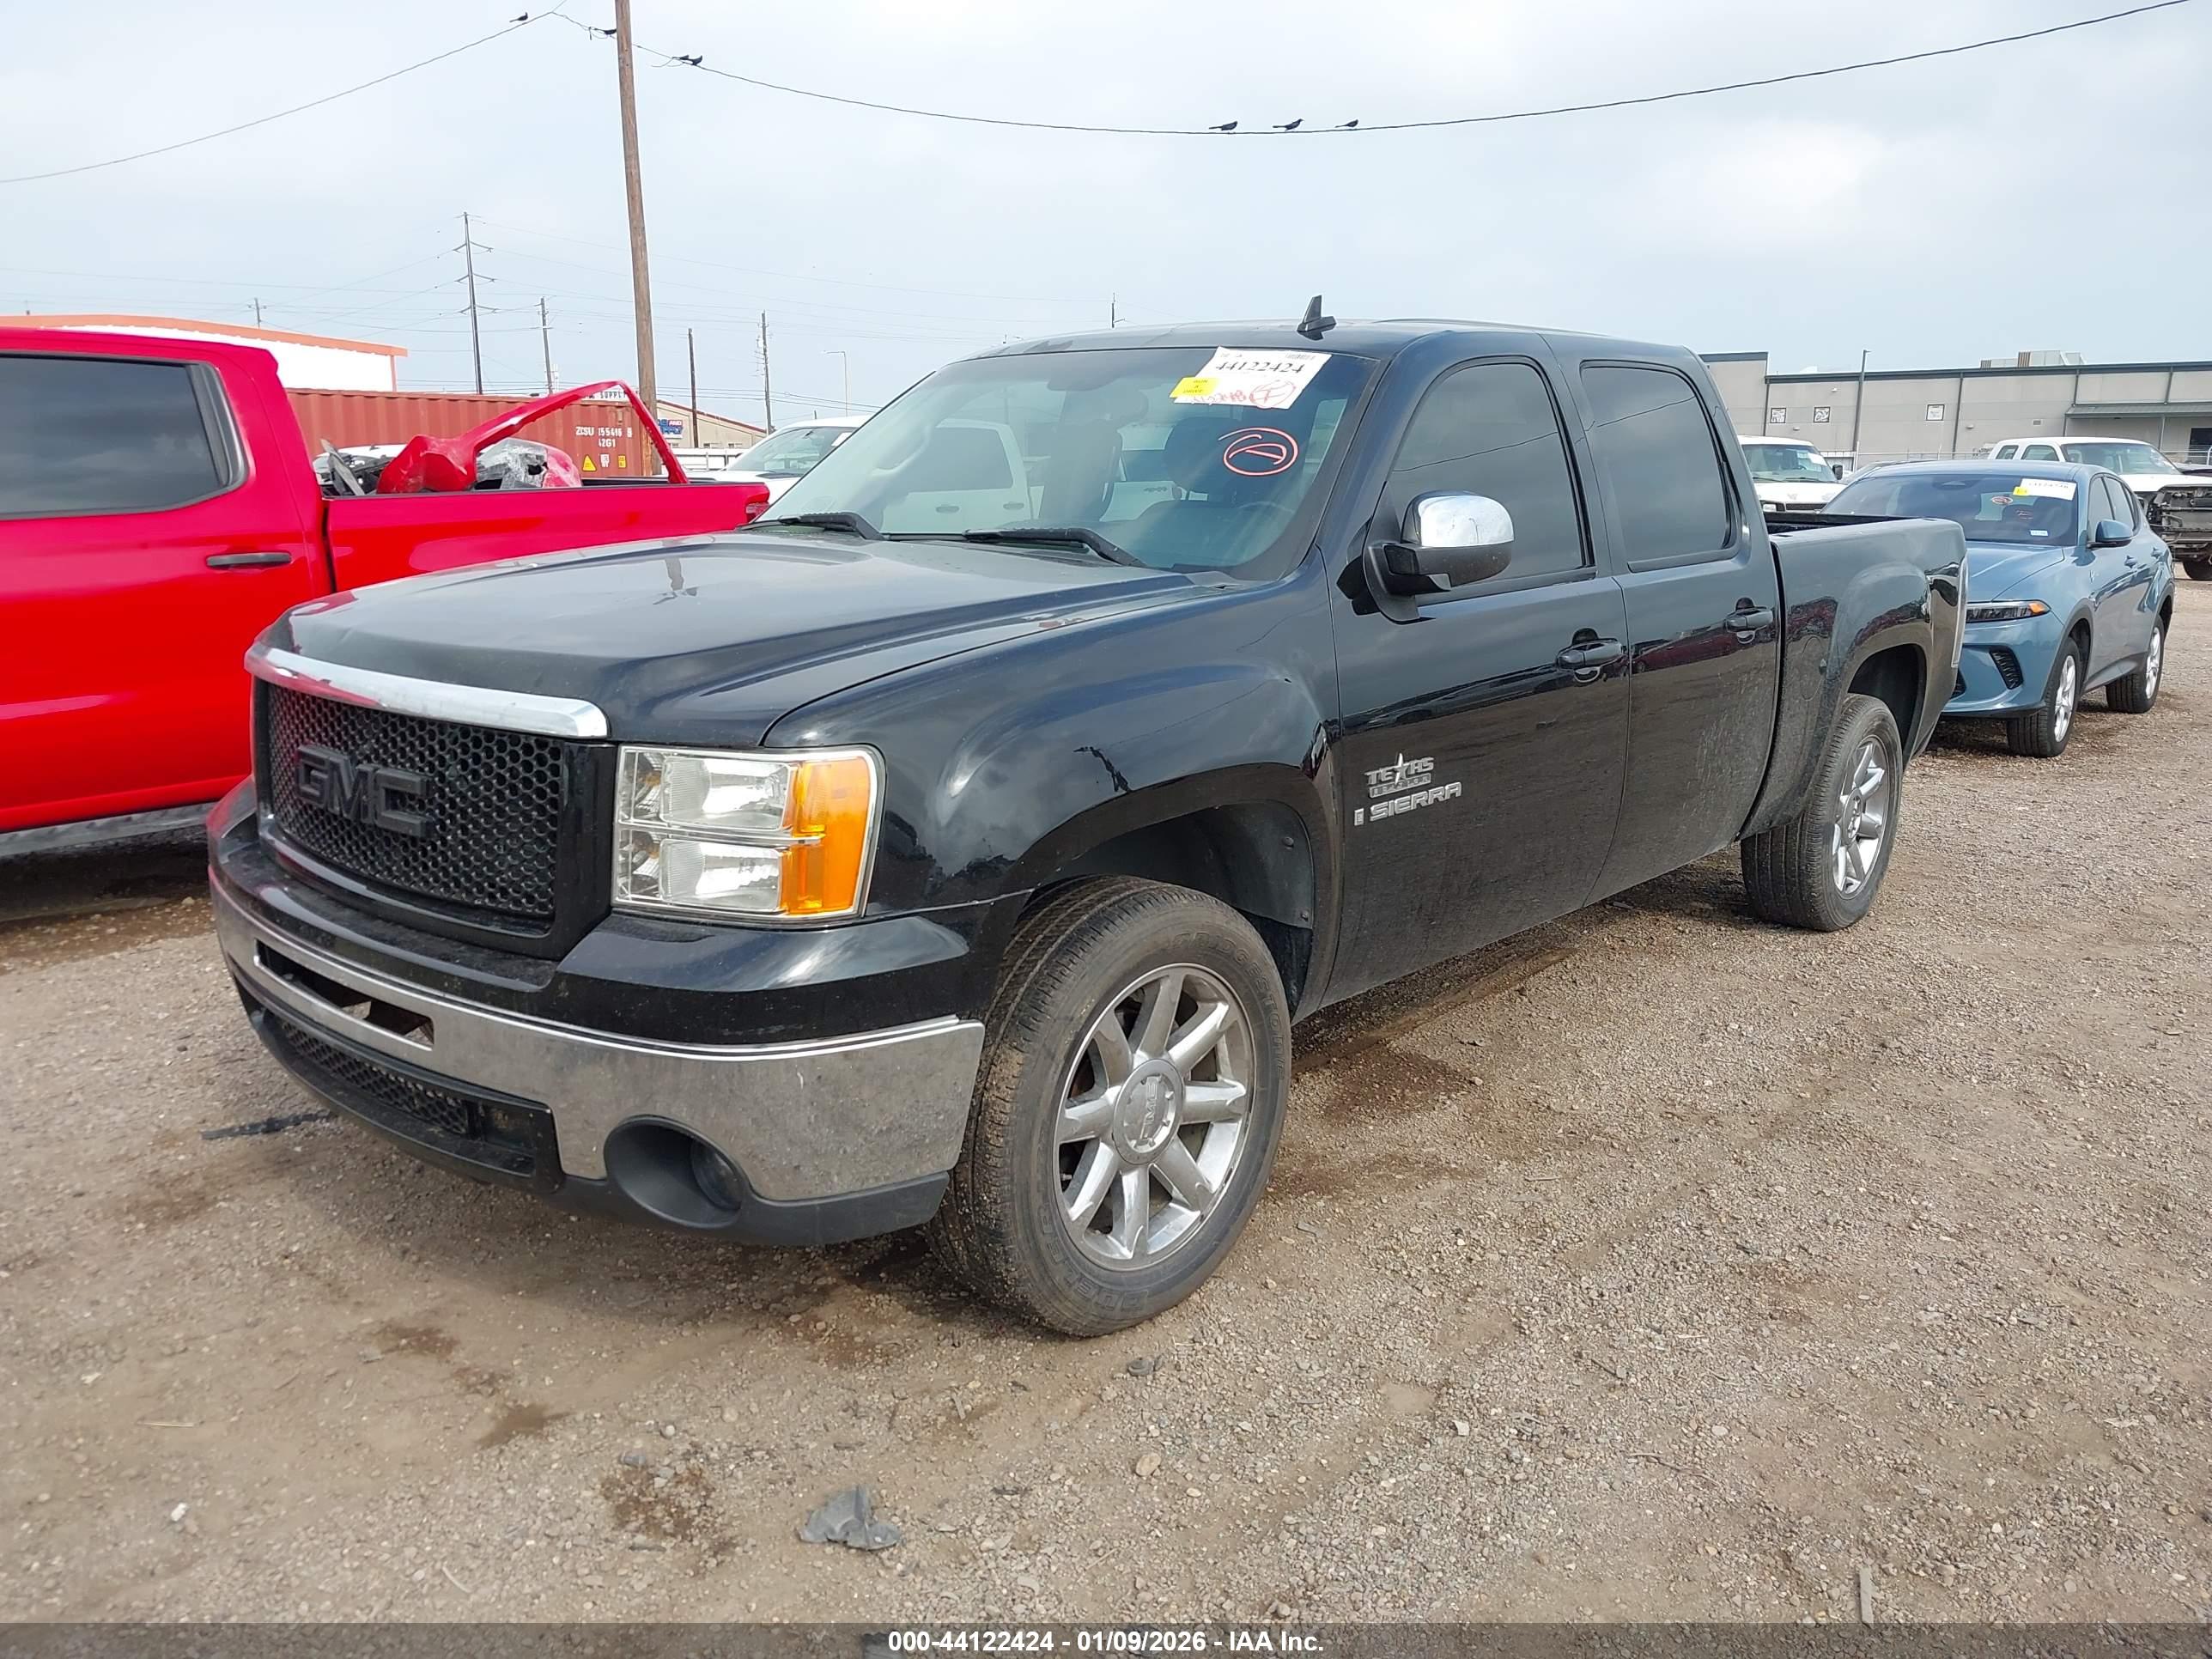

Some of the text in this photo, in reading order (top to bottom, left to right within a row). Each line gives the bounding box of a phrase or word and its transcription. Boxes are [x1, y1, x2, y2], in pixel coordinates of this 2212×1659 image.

[1216, 362, 1305, 374] 44122424
[1364, 753, 1435, 785] TEXAS
[297, 744, 433, 839] GMC
[1370, 781, 1462, 822] SIERRA
